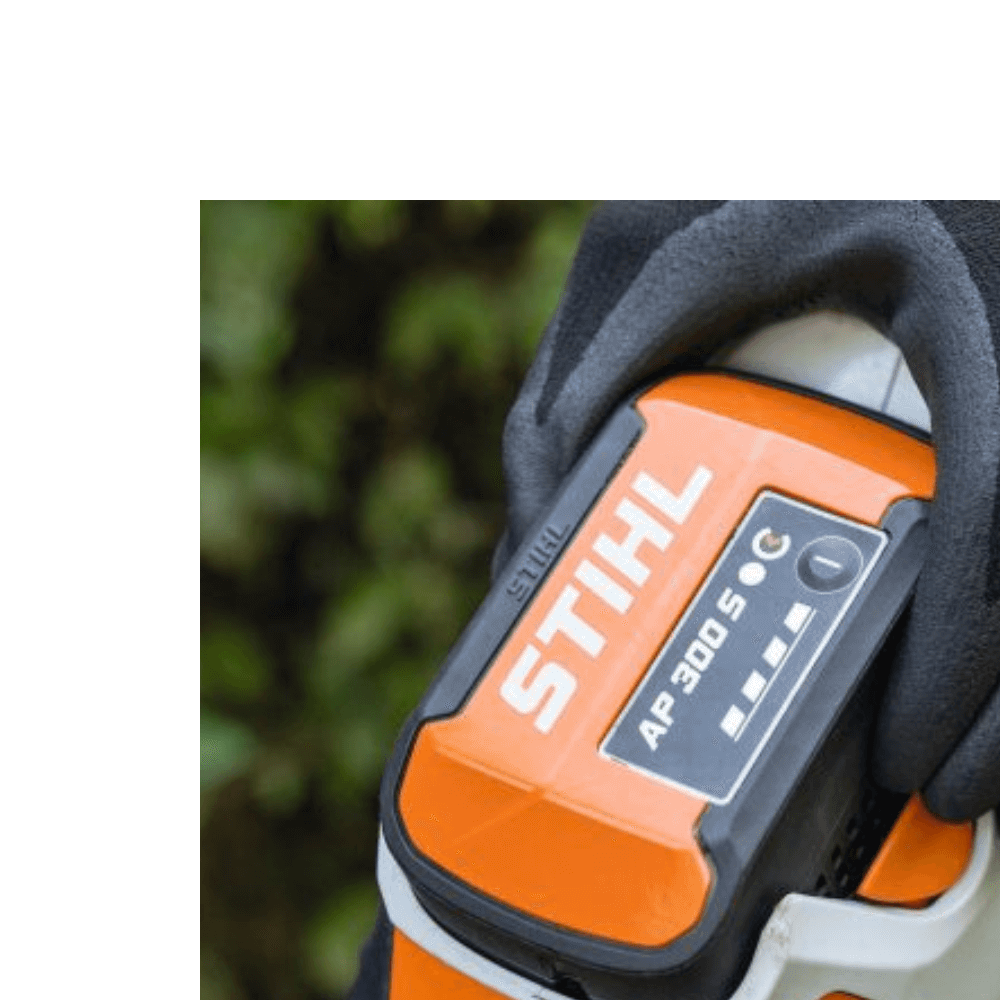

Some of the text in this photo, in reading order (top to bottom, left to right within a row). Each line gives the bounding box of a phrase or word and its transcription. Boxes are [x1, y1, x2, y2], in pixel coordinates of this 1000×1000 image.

[501, 465, 713, 734] STIHL
[506, 524, 571, 602] STIHL
[637, 588, 747, 751] AP 300 S
